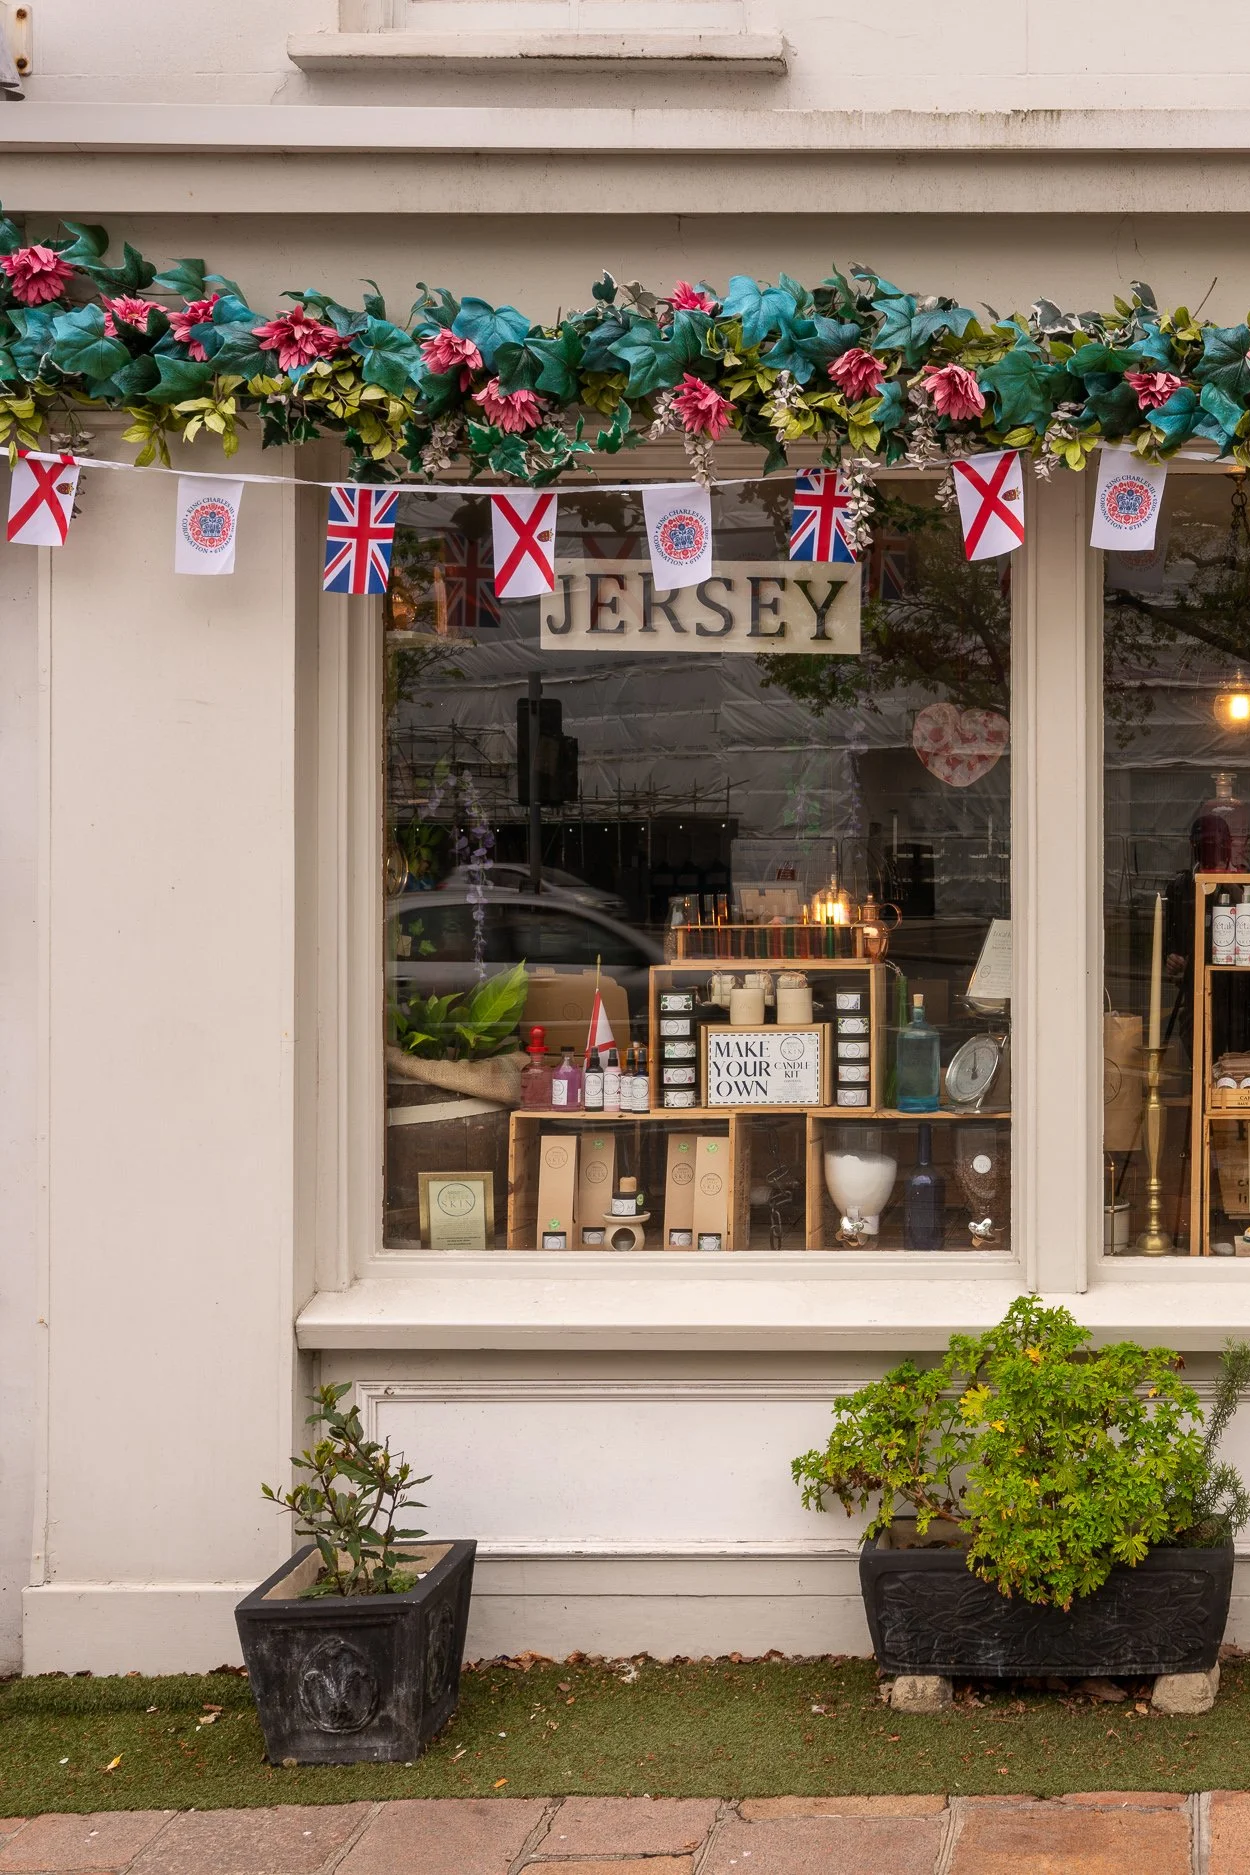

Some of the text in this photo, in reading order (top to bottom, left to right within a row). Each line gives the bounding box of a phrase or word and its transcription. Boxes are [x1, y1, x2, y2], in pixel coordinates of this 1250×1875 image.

[1106, 476, 1120, 489] KING
[1122, 474, 1150, 488] CHARLES
[186, 499, 202, 514] KING
[202, 498, 230, 508] CHARLES
[1100, 493, 1122, 530] CORONATION
[656, 514, 668, 530] KING
[668, 508, 699, 518] CHARLES
[1142, 513, 1153, 524] MAY
[182, 518, 208, 554] CORONATION
[654, 535, 684, 566] CORONATION
[700, 541, 708, 556] MAY
[546, 572, 848, 640] JERSEY
[714, 1041, 770, 1058] MAKE
[712, 1060, 771, 1077] YOUR
[784, 1070, 800, 1078] KIT
[716, 1080, 768, 1098] OWN
[441, 1200, 472, 1208] SKIN
